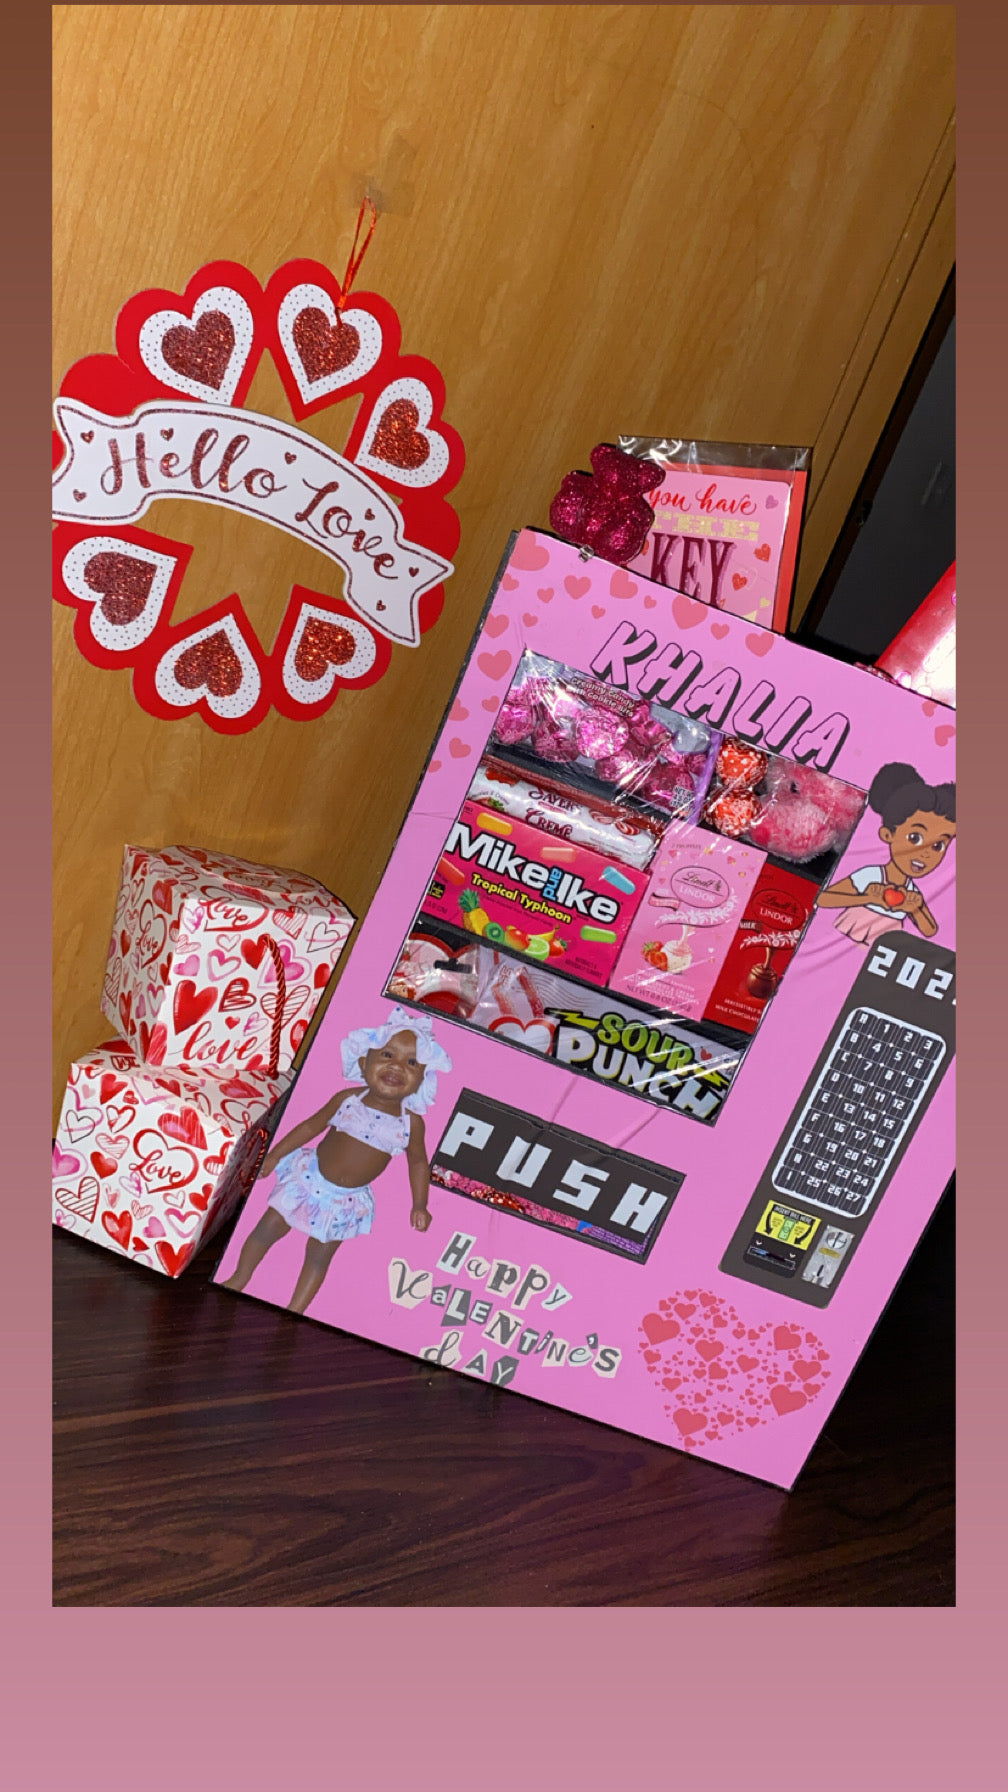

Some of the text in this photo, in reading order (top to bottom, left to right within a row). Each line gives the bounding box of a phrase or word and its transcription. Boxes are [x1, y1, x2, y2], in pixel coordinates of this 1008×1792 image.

[101, 427, 398, 579] Hello Love
[649, 483, 757, 515] you have
[650, 532, 736, 609] KEY
[590, 620, 850, 774] KHALIA
[444, 821, 549, 890] Mike
[542, 867, 563, 901] and
[555, 873, 619, 923] Ike
[472, 873, 519, 902] Tropical
[520, 893, 573, 924] Typhoon
[759, 907, 794, 926] LINDOR
[867, 945, 956, 1006] 202
[182, 1020, 258, 1064] love
[597, 1013, 693, 1074] SOUR
[872, 1043, 881, 1053] 4
[894, 1052, 903, 1061] 5
[884, 1024, 890, 1033] 1
[904, 1032, 913, 1042] 2
[924, 1040, 933, 1050] 3
[555, 1025, 721, 1119] PUNCH
[864, 1062, 872, 1071] 7
[885, 1070, 894, 1080] 8
[906, 1078, 914, 1088] 9
[853, 1083, 865, 1094] 10
[875, 1092, 886, 1103] 11
[893, 1098, 906, 1110] 12
[844, 1103, 856, 1114] 13
[864, 1111, 877, 1122] 14
[883, 1118, 896, 1130] 15
[834, 1122, 846, 1133] 16
[854, 1130, 867, 1141] 17
[874, 1137, 886, 1148] 18
[129, 1149, 183, 1183] Love
[826, 1142, 838, 1153] 19
[845, 1149, 860, 1161] 20
[864, 1156, 878, 1168] 21
[439, 1112, 668, 1234] PUSH
[807, 1176, 821, 1188] 25
[828, 1185, 842, 1196] 26
[846, 1192, 861, 1202] 27
[815, 1160, 829, 1172] 22
[836, 1167, 851, 1179] 23
[853, 1175, 869, 1187] 24
